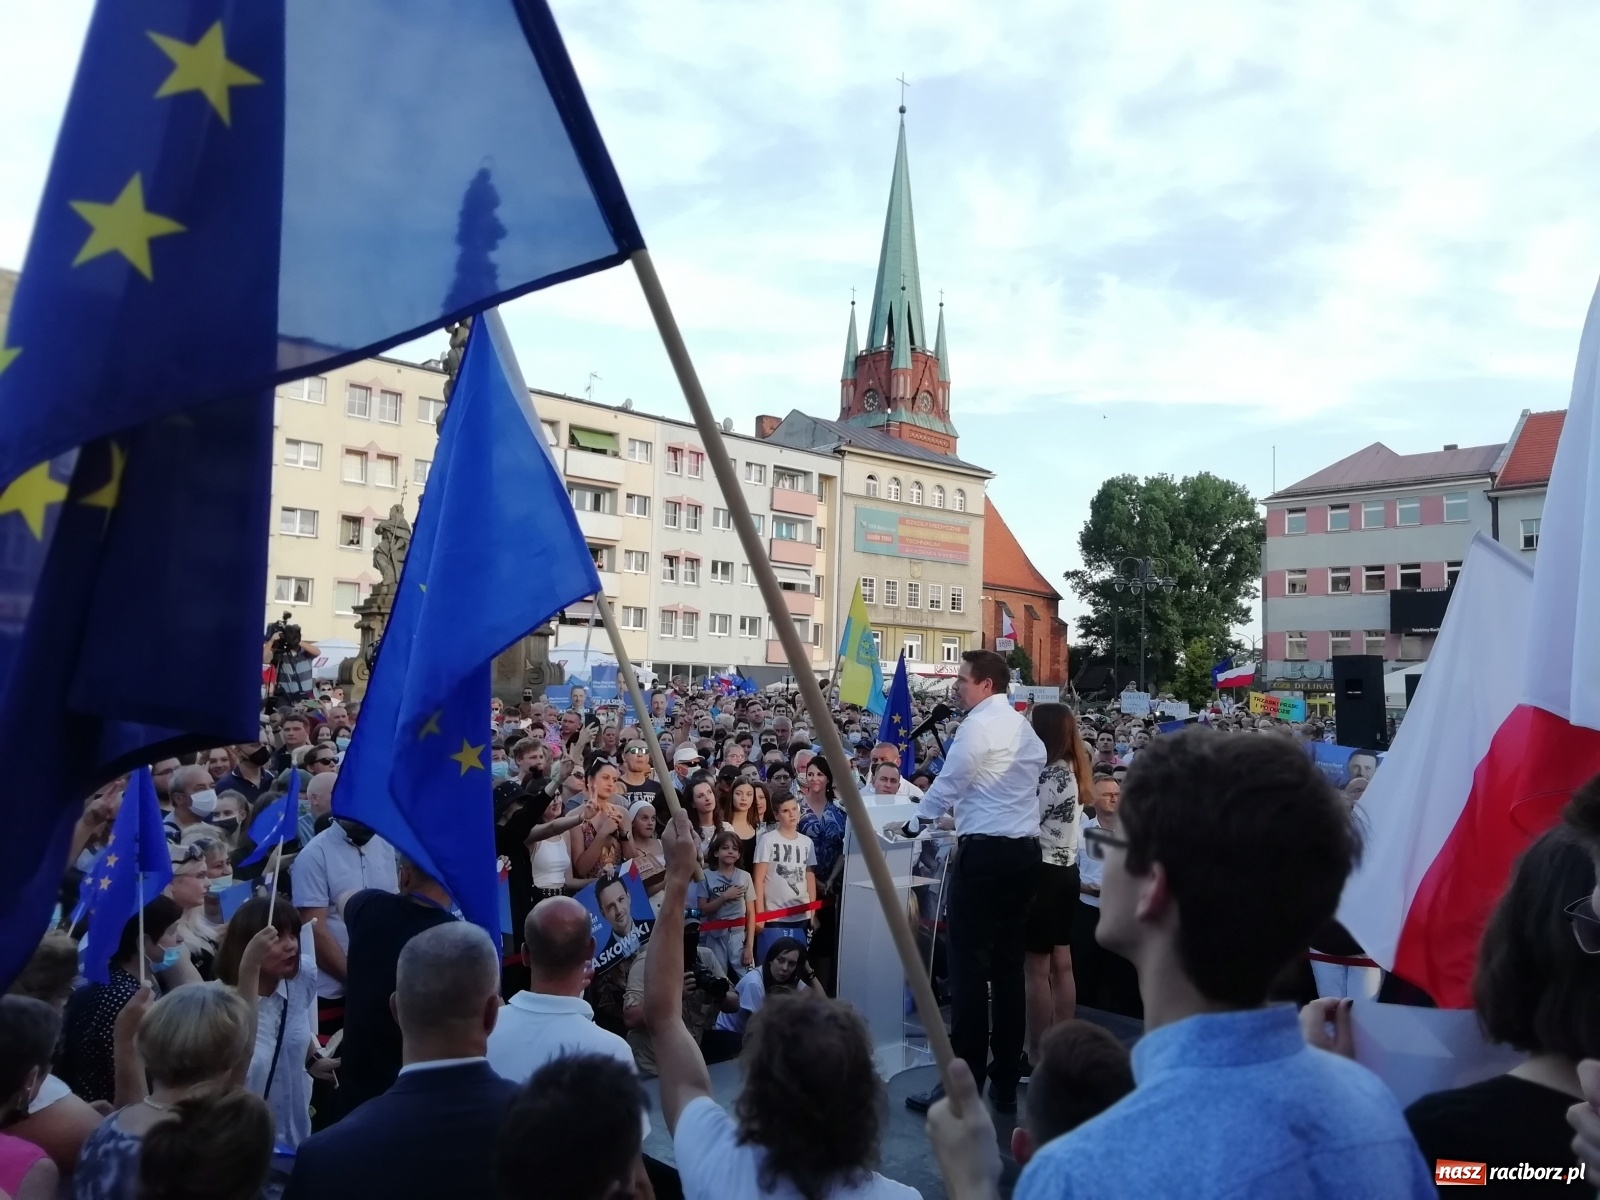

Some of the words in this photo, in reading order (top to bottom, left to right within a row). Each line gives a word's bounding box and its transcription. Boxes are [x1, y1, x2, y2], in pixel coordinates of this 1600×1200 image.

[905, 538, 941, 547] TECHNIKUM
[905, 548, 937, 557] AKADEMIA
[1294, 682, 1334, 690] DELIKAT
[591, 922, 650, 970] ASKOWSKI
